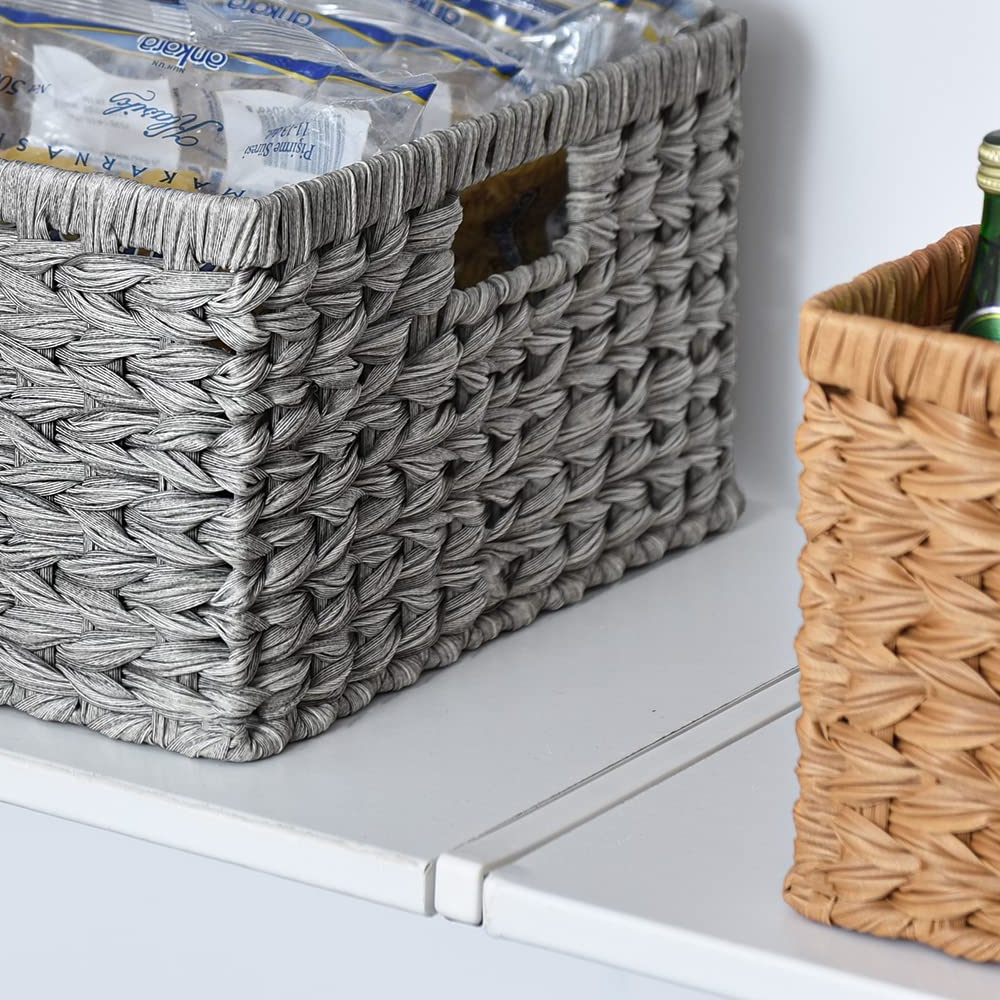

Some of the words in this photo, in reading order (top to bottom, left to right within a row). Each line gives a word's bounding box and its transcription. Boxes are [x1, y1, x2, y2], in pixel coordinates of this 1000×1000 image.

[137, 35, 228, 70] ankara
[103, 90, 224, 147] Klasik
[242, 142, 274, 160] Süresi
[273, 138, 315, 161] Pişirme
